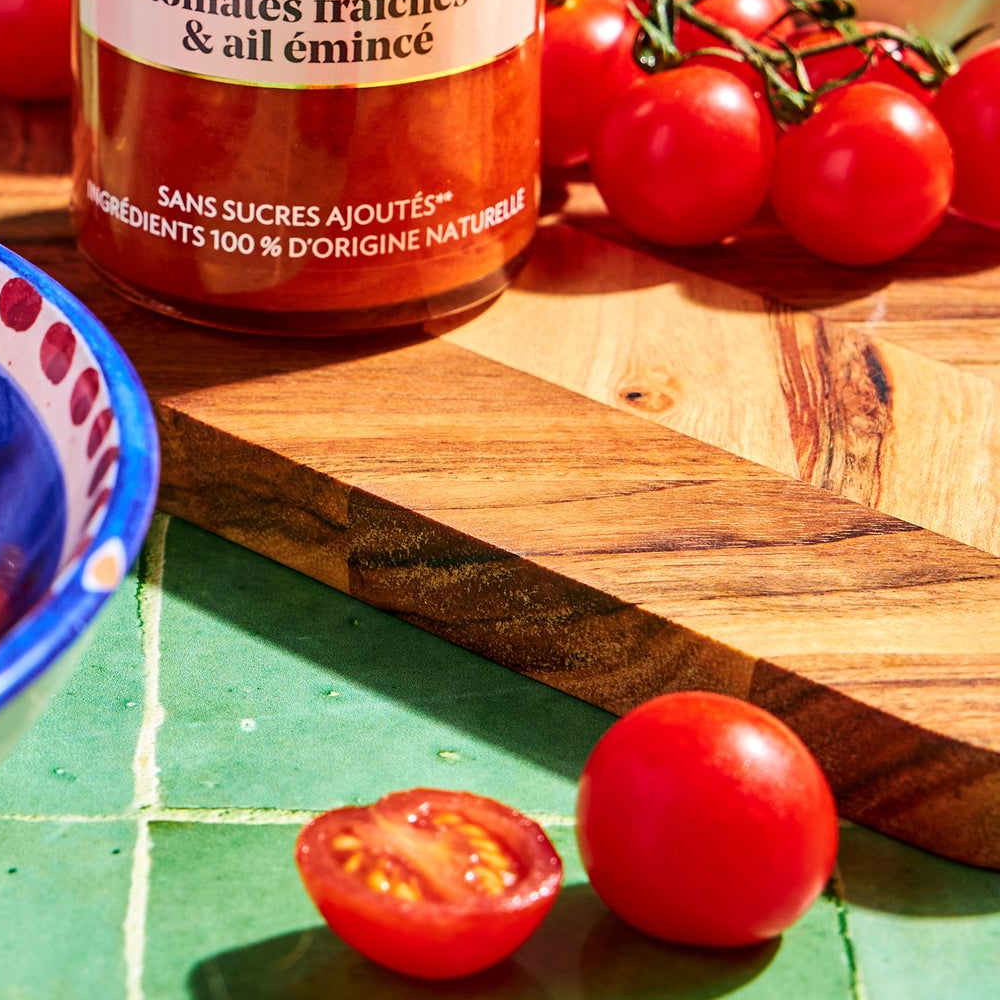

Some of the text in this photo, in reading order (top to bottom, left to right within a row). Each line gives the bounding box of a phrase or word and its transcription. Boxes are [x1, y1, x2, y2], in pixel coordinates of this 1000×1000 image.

[182, 19, 434, 64] & ail émincé
[86, 179, 206, 247] INGRÉDIENTS
[210, 229, 255, 255] 100
[259, 236, 282, 258] %
[424, 186, 527, 246] NATURELLE
[157, 185, 219, 219] SANS
[222, 199, 320, 227] SUCRES
